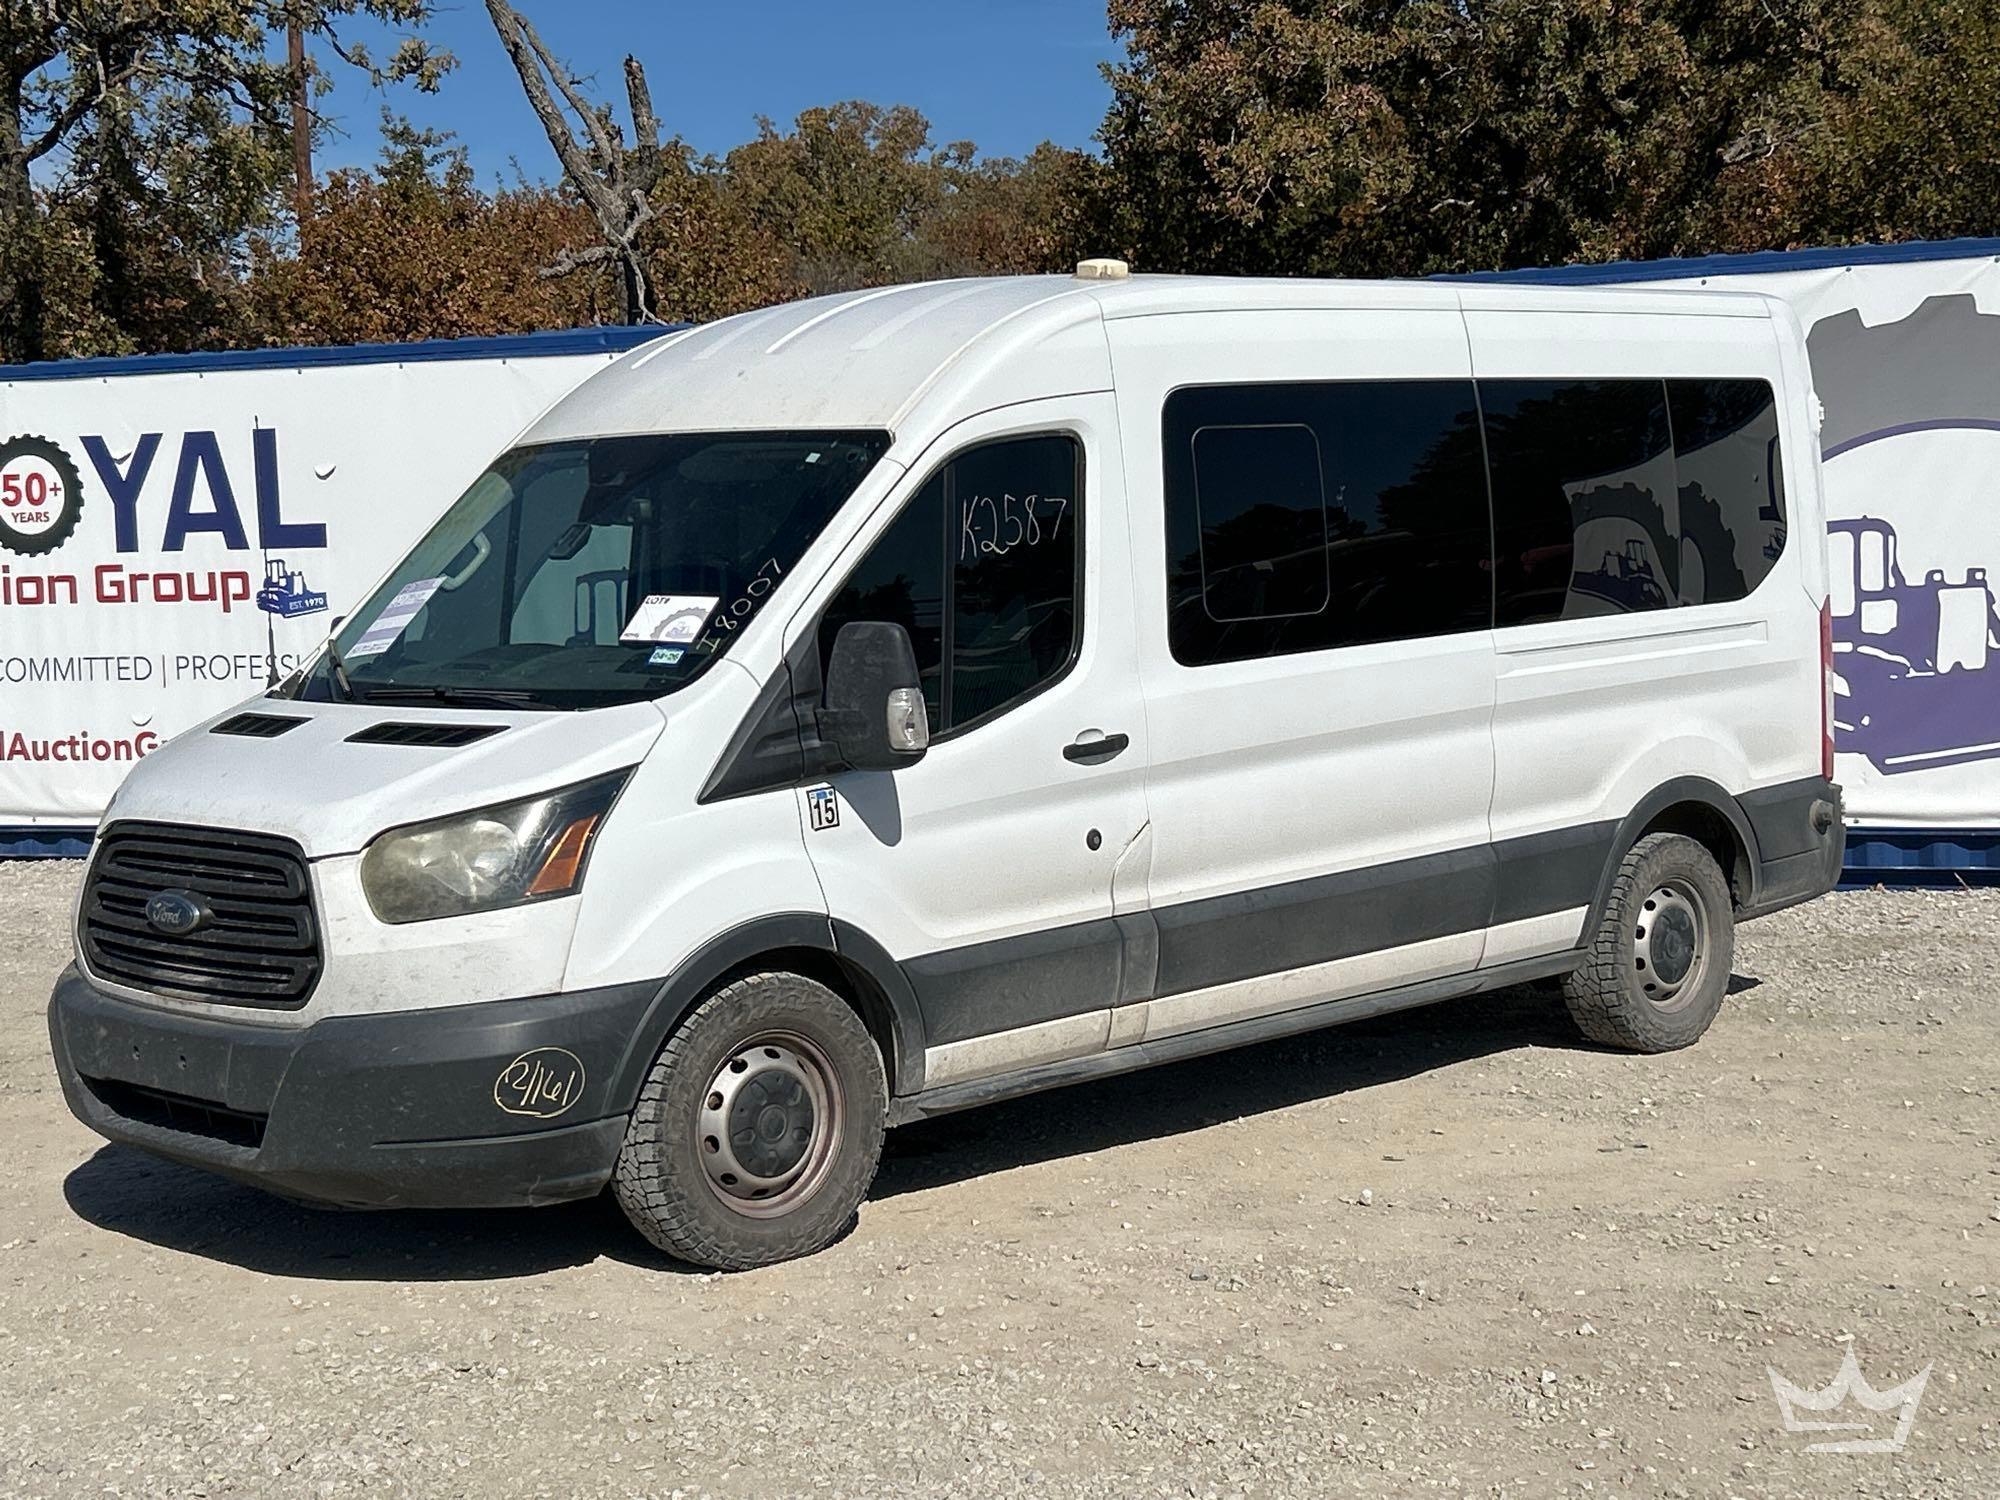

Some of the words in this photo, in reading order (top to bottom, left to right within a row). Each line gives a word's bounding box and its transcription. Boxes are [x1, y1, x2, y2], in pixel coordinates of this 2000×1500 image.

[2, 472, 62, 507] 50+
[11, 511, 50, 523] YEARS
[2, 565, 78, 605] ion
[95, 564, 250, 613] Group
[305, 597, 324, 607] 1970
[0, 655, 152, 683] OMMITTED
[813, 797, 835, 826] 15
[151, 902, 182, 924] Ford
